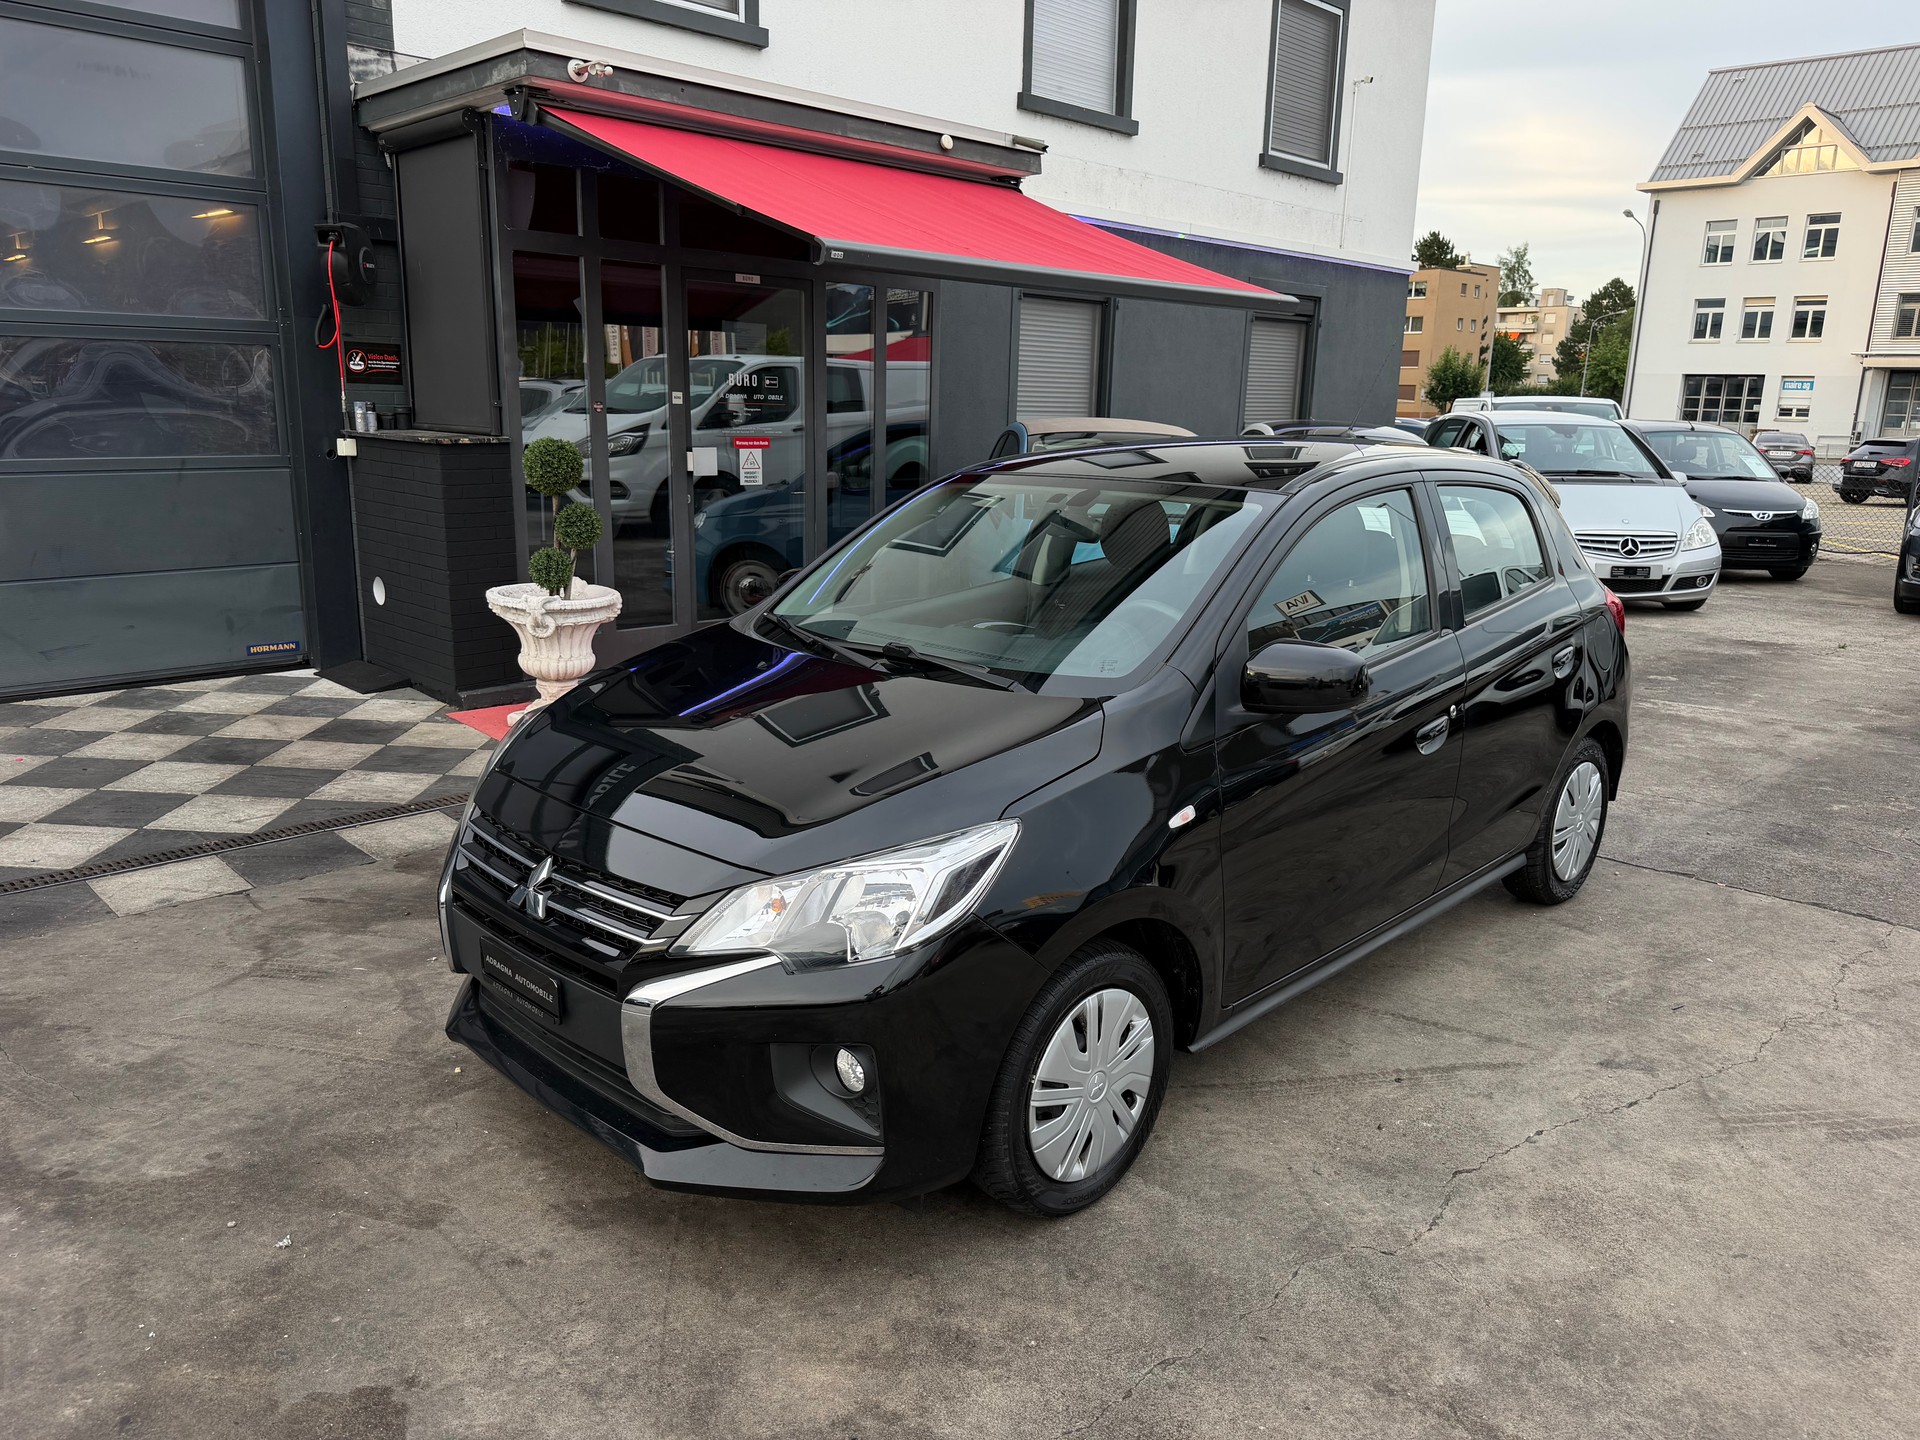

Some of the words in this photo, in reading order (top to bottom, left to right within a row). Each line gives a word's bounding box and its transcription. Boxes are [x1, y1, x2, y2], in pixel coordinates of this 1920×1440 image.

[728, 371, 758, 387] BÜRO
[485, 954, 513, 978] ADRAGNA
[514, 973, 554, 1003] AUTOMOBILE
